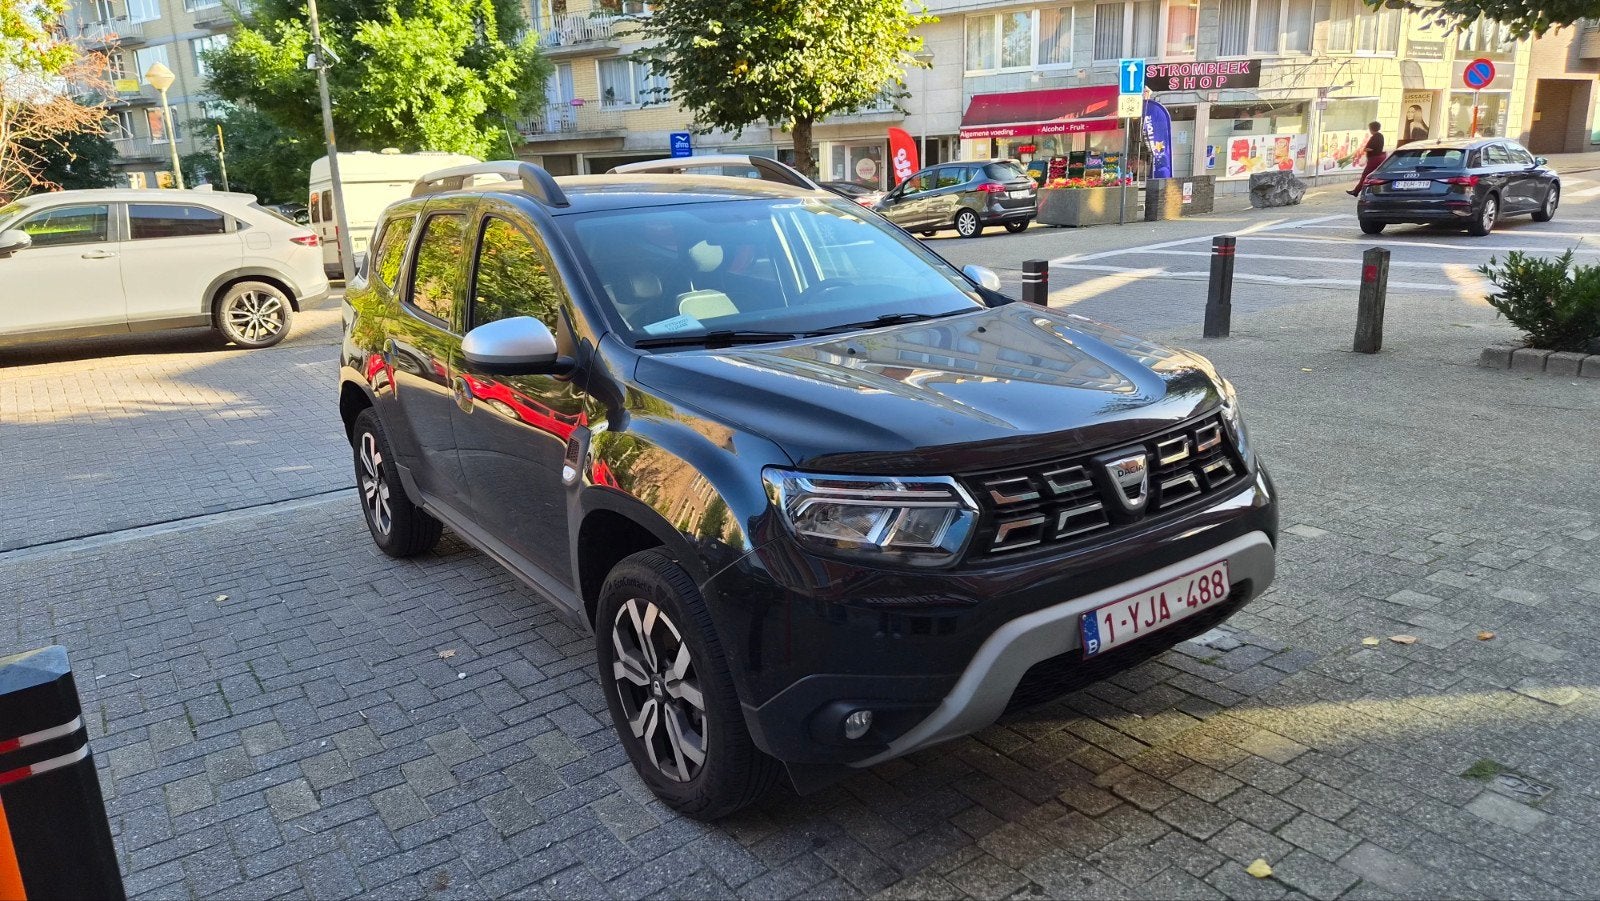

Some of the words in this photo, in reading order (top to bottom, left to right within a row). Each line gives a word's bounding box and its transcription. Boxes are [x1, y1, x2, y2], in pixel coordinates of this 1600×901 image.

[1146, 61, 1250, 78] STROMBEEK
[1168, 76, 1227, 90] SHOP
[960, 130, 989, 138] Algemene
[1041, 125, 1065, 133] Alcohol
[1117, 464, 1143, 478] DACIA
[1104, 569, 1225, 643] 1-YJA-488
[1087, 639, 1099, 655] B
